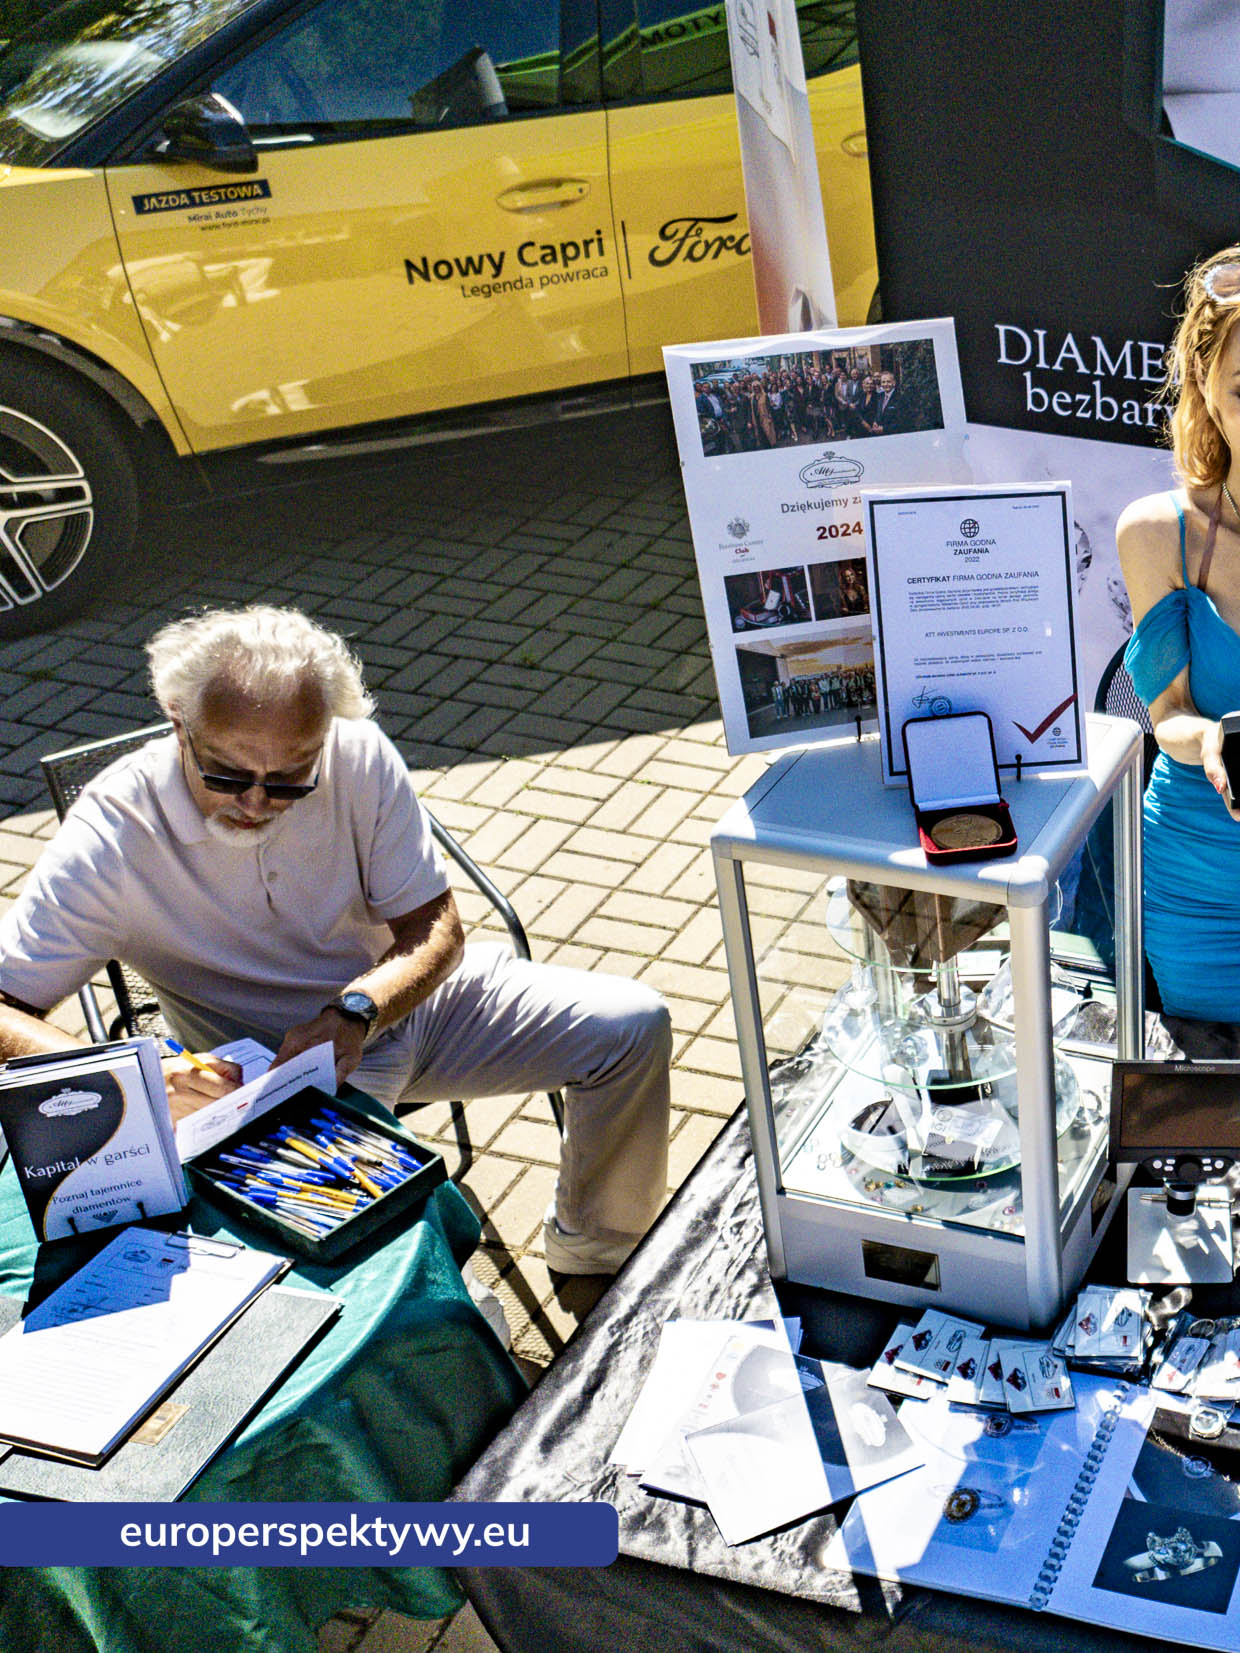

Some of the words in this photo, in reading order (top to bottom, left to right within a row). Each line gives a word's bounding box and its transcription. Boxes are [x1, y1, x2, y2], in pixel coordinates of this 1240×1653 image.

[143, 194, 190, 211] JAZDA
[190, 184, 264, 204] TESTOWA
[404, 250, 505, 286] Nowy
[517, 229, 605, 268] Capri
[461, 277, 534, 299] Legenda
[539, 264, 609, 290] powraca
[781, 498, 849, 514] Dziękujemy
[816, 521, 863, 540] 2024
[946, 540, 970, 548] FIRMA
[970, 538, 996, 547] GODNA
[953, 547, 990, 556] ZAUFANIA
[906, 576, 950, 585] CERTYFIKAT
[952, 573, 975, 582] FIRMA
[976, 572, 1002, 581] GODNA
[1003, 570, 1040, 580] ZAUFANIA
[1174, 1064, 1216, 1073] Microscope
[24, 1157, 81, 1179] Kapitał
[87, 1156, 101, 1166] w
[104, 1143, 151, 1166] garści
[53, 1190, 89, 1205] Poznaj
[90, 1178, 143, 1197] tajemnice
[72, 1195, 131, 1215] diamentów
